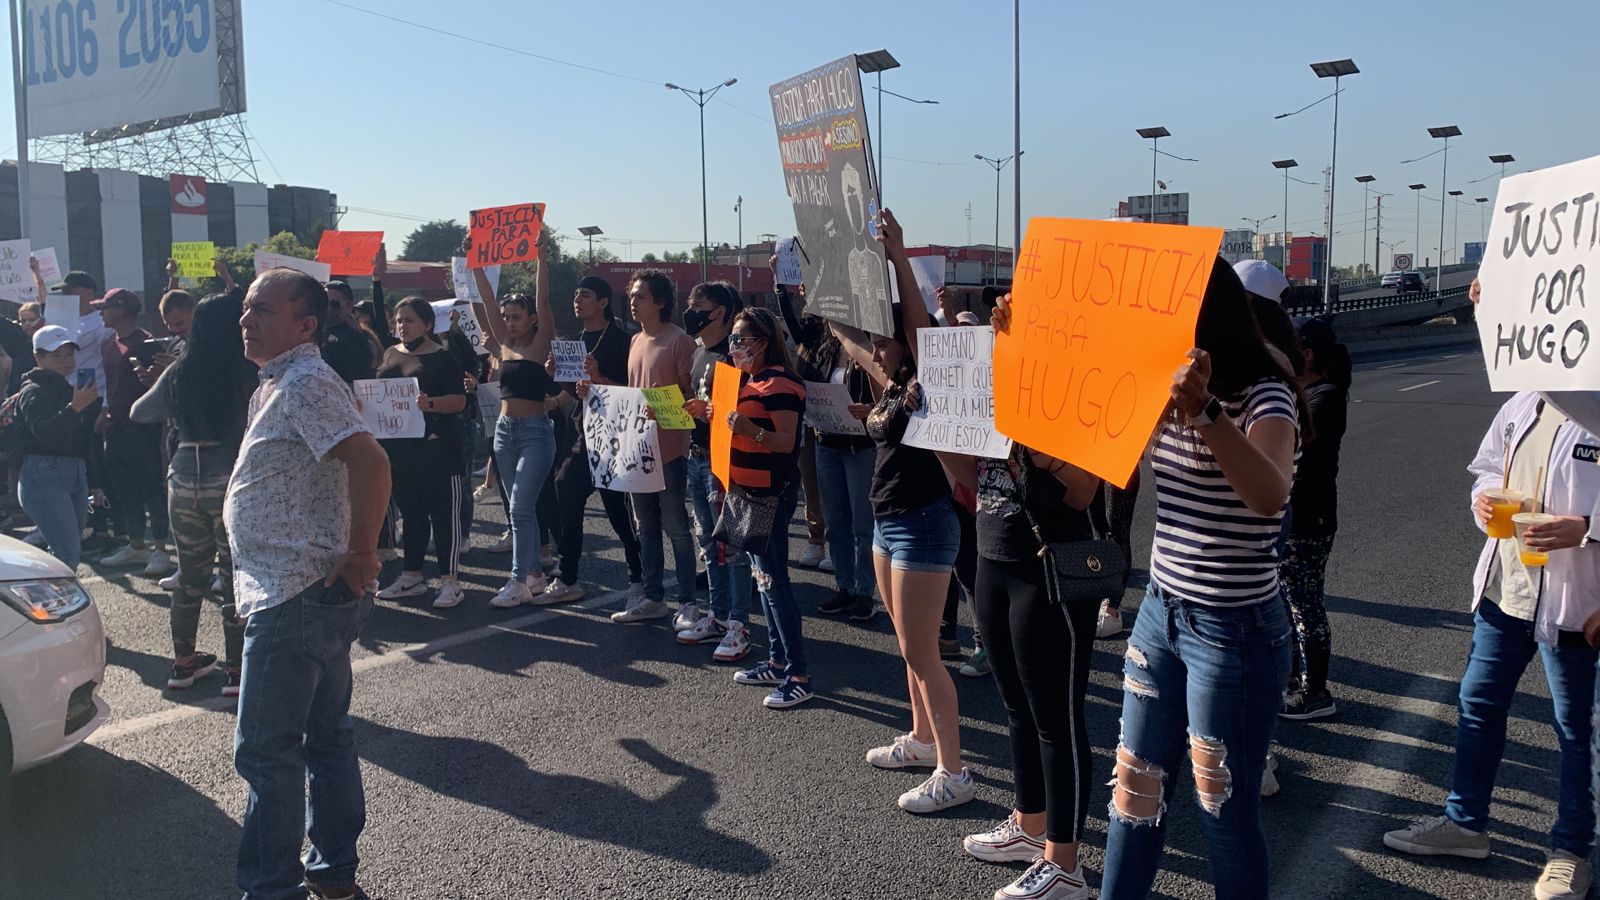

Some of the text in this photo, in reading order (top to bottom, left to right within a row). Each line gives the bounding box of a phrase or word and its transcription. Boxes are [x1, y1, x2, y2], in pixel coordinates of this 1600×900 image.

[27, 0, 211, 86] 1106 2055
[774, 67, 856, 126] JUSTICIA PARA HUGO
[470, 206, 543, 230] JUSTICIA
[491, 223, 532, 242] PARA
[1503, 192, 1600, 260] JUSTI
[477, 239, 529, 263] HUGO
[1046, 237, 1207, 316] JUSTICIA
[1530, 264, 1586, 315] POR
[1023, 303, 1089, 351] PARA
[924, 330, 977, 361] HERMANO
[1494, 318, 1590, 374] HUGO
[922, 365, 994, 390] PROMETI QUE
[921, 397, 995, 419] HASTA LA MUE
[1016, 356, 1137, 443] HUGO
[377, 410, 404, 435] Hugo
[911, 422, 922, 438] Y
[955, 426, 991, 451] ESTOY
[1576, 446, 1600, 460] NAS
